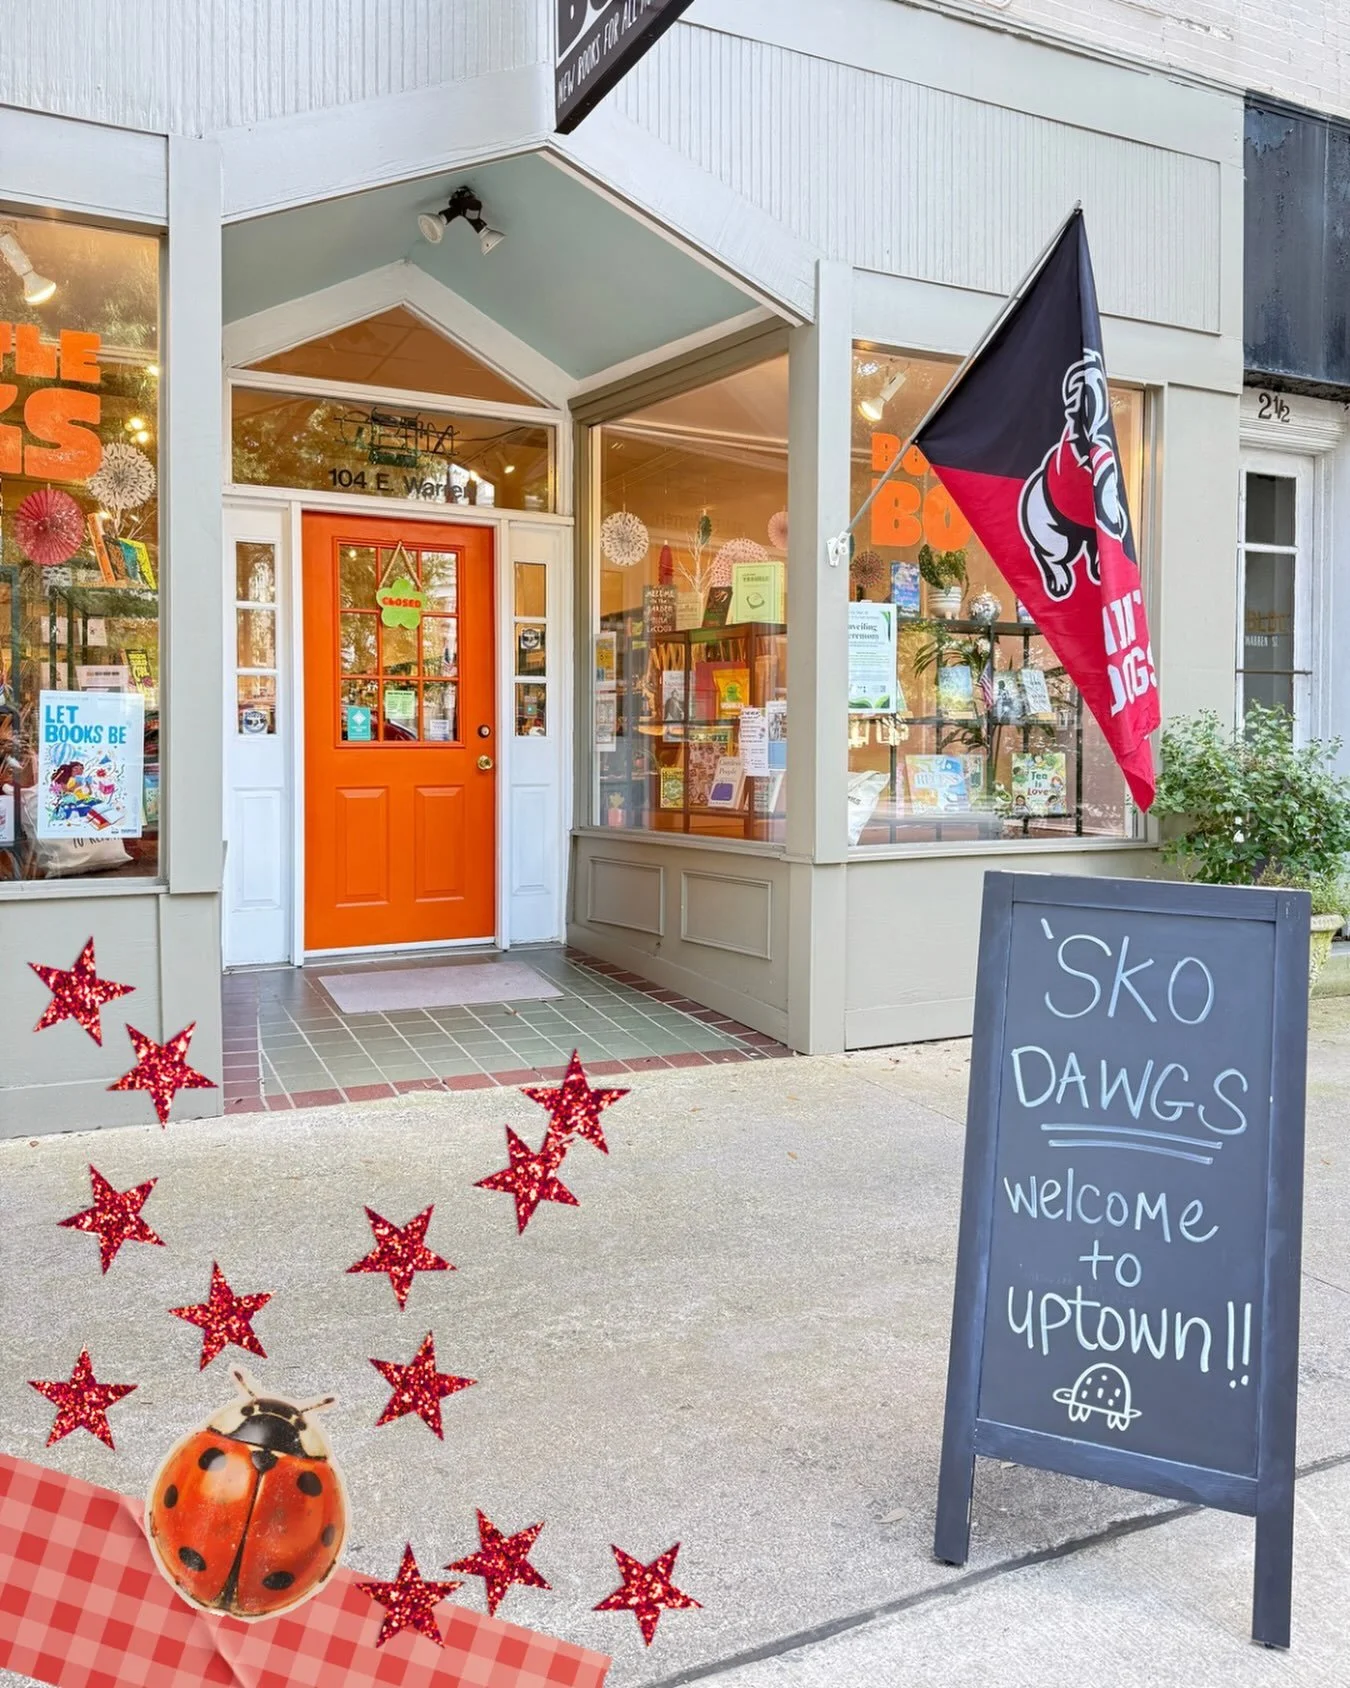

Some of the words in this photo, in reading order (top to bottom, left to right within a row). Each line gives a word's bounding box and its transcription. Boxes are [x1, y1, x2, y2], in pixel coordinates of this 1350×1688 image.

[557, 64, 576, 108] NEW
[578, 33, 601, 86] BOOKS
[603, 12, 620, 56] FOR
[328, 468, 367, 489] 104
[376, 473, 394, 492] E.
[382, 596, 422, 608] CLOSED
[45, 704, 79, 723] LET
[45, 725, 103, 743] BOOKS
[108, 726, 127, 744] BE
[1011, 1045, 1249, 1136] DAWGS
[1078, 1240, 1142, 1287] to
